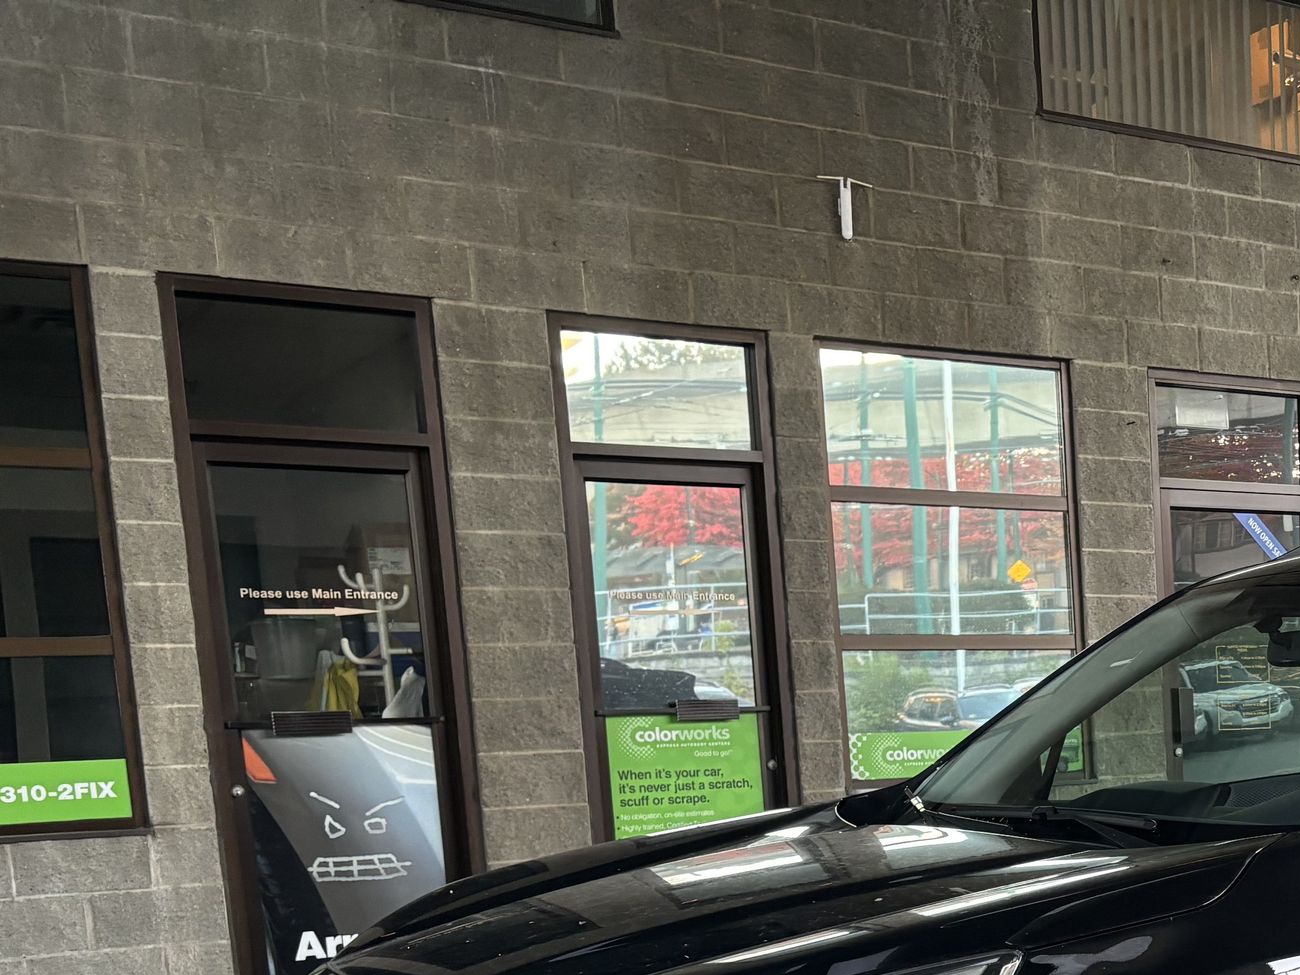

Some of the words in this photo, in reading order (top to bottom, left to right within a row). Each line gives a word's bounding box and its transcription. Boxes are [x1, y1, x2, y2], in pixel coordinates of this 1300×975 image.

[1247, 517, 1262, 535] NOW
[1259, 532, 1275, 550] OPEN
[239, 588, 282, 599] Please
[286, 590, 309, 599] use
[312, 588, 341, 599] Main
[345, 588, 399, 600] Entrance
[610, 590, 643, 600] Please
[646, 592, 663, 600] use
[666, 591, 690, 600] Main
[693, 591, 736, 601] Entrance
[635, 725, 730, 742] colorworks
[886, 746, 947, 761] colorwo
[617, 770, 652, 780] When
[655, 768, 672, 779] it's
[674, 769, 700, 781] your
[703, 768, 724, 778] car,
[0, 780, 118, 803] 310-2FIX
[619, 783, 636, 794] it's
[639, 783, 671, 793] never
[674, 780, 696, 793] just
[698, 782, 705, 790] a
[708, 778, 753, 790] scratch,
[620, 795, 649, 807] scuff
[652, 796, 665, 805] or
[667, 794, 710, 806] scrape.
